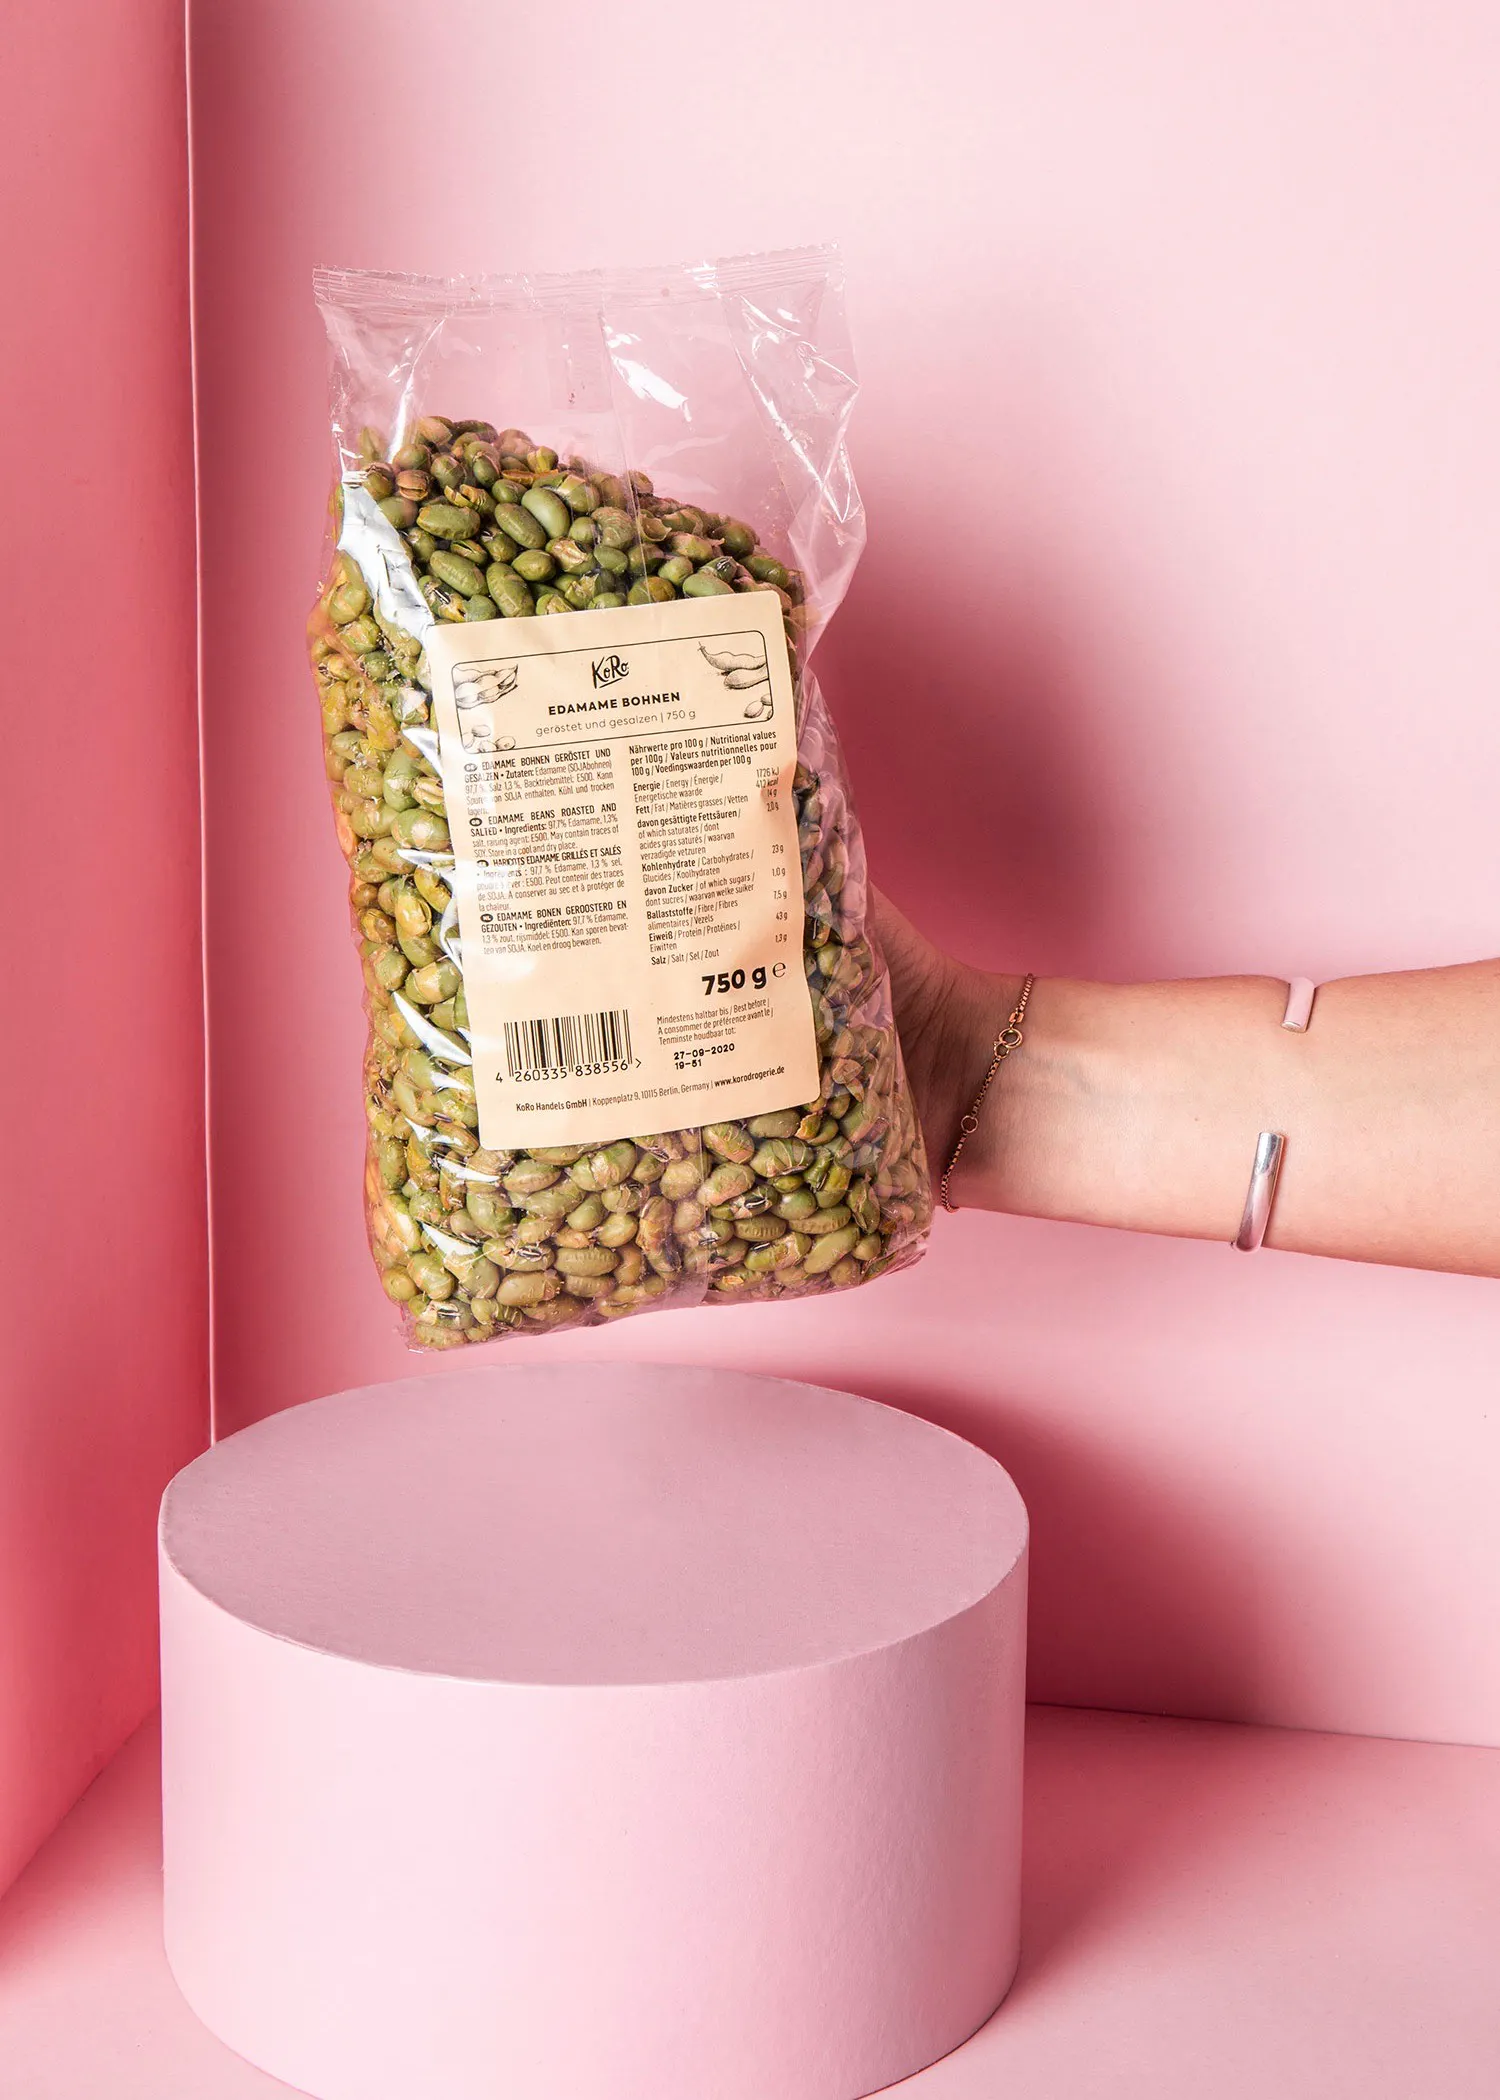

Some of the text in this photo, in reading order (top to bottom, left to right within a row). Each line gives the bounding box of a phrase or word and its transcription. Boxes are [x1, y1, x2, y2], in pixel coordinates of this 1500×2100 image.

[592, 655, 629, 689] KoRo
[549, 692, 680, 715] EDAMAME BOHNEN
[536, 710, 696, 737] geröstet und gesalzen 750 g
[629, 731, 776, 754] Nährwerte pro 100 Nutritional values
[521, 748, 611, 766] BOHNEN GERÖSTET UND
[631, 742, 777, 767] per 100g Valeurs nutritionnelles pour
[535, 766, 566, 776] Edamame
[632, 755, 744, 776] 100 Voedingswaarden per 100
[756, 767, 779, 778] 1726 kJ
[597, 771, 613, 780] Kann
[633, 774, 719, 792] Energie Energy Énergie
[504, 791, 522, 801] SOJA
[576, 784, 588, 794] und
[590, 782, 614, 792] trocken
[634, 788, 703, 803] Energetische waarde
[636, 795, 748, 814] Fett Fat Matières grasses Vetten
[488, 813, 524, 825] EDAMAME
[531, 810, 555, 820] BEANS
[561, 805, 595, 817] ROASTED
[601, 803, 616, 812] AND
[637, 810, 737, 828] davon gesättigte Fettsäuren
[471, 823, 547, 837] SALTED Ingredients:
[550, 831, 563, 841] May
[565, 828, 589, 839] contain
[591, 827, 611, 836] traces
[646, 823, 719, 837] which saturates dont
[640, 832, 735, 850] acides gras saturés waarvan
[488, 850, 504, 858] Store
[518, 845, 532, 855] cool
[533, 844, 545, 853] and
[547, 843, 557, 852] dry
[526, 845, 621, 865] EDAMAME GRILLÉS ET SALÉS
[640, 847, 706, 860] verzadigde vetzuren
[642, 852, 750, 872] Kohlenhydrate Carbohydrates
[545, 870, 624, 885] Peut contenir des traces
[643, 867, 720, 883] Glucides Koolhydraten
[515, 889, 546, 899] conserver
[559, 886, 570, 894] sec
[587, 881, 614, 892] protéger
[617, 879, 625, 888] de
[644, 875, 751, 896] davon Zucker which sugars
[645, 884, 754, 907] dont sucres waarvan welke suiker
[497, 910, 532, 921] EDAMAME
[537, 908, 561, 918] BONEN
[566, 902, 613, 915] GEROOSTERD
[617, 900, 627, 909] EN
[647, 900, 738, 920] Ballaststoffe Fibre Fibres
[481, 923, 517, 933] GEZOUTEN
[571, 923, 628, 936] Kan sporen bevat-
[648, 915, 714, 931] alimentaires Vezels
[649, 923, 737, 942] Eiweiß Protein Protéines
[527, 941, 571, 952] Koel droog
[650, 943, 677, 953] Eiwitten
[651, 949, 719, 965] Salz Salt Sel Zout
[702, 969, 745, 996] 750
[752, 967, 767, 989] g
[657, 999, 766, 1025] Mindestens haltbar bis Best before
[664, 1010, 764, 1035] consommer de préférence avant
[659, 1030, 723, 1045] Tenminste houdbaar
[674, 1043, 735, 1060] 27-09-2020
[496, 1060, 628, 1083] 4 260335 838556
[516, 1066, 784, 1111] KoRo Handels GmbH Koppenplatz 10115 Germany www.korodrogerie.de
